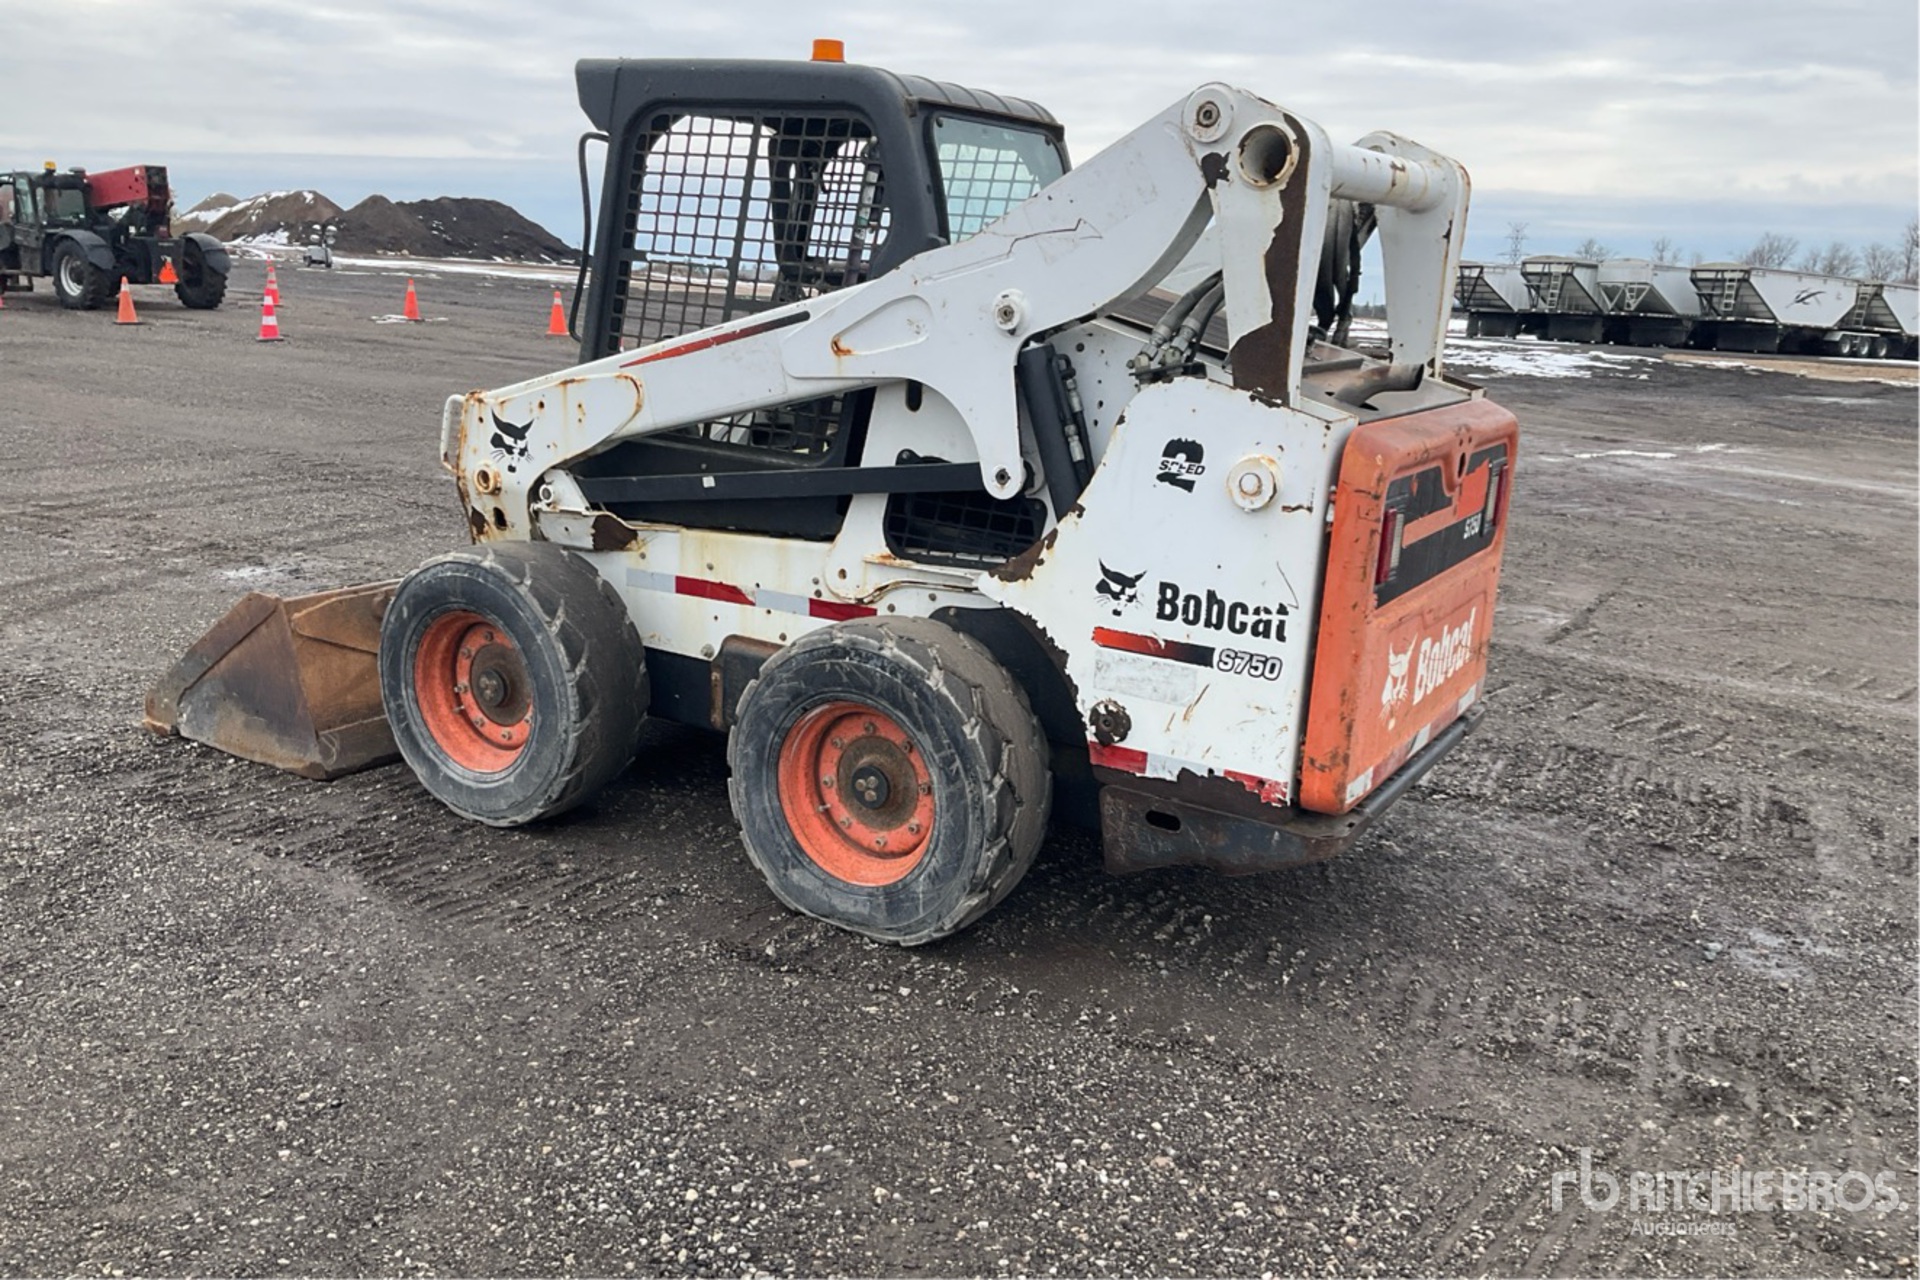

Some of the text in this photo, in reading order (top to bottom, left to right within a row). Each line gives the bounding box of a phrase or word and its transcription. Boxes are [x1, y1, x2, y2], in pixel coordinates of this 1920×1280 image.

[1156, 581, 1290, 643] Bobcat
[1217, 648, 1283, 681] S750
[1413, 606, 1476, 705] Bobcat
